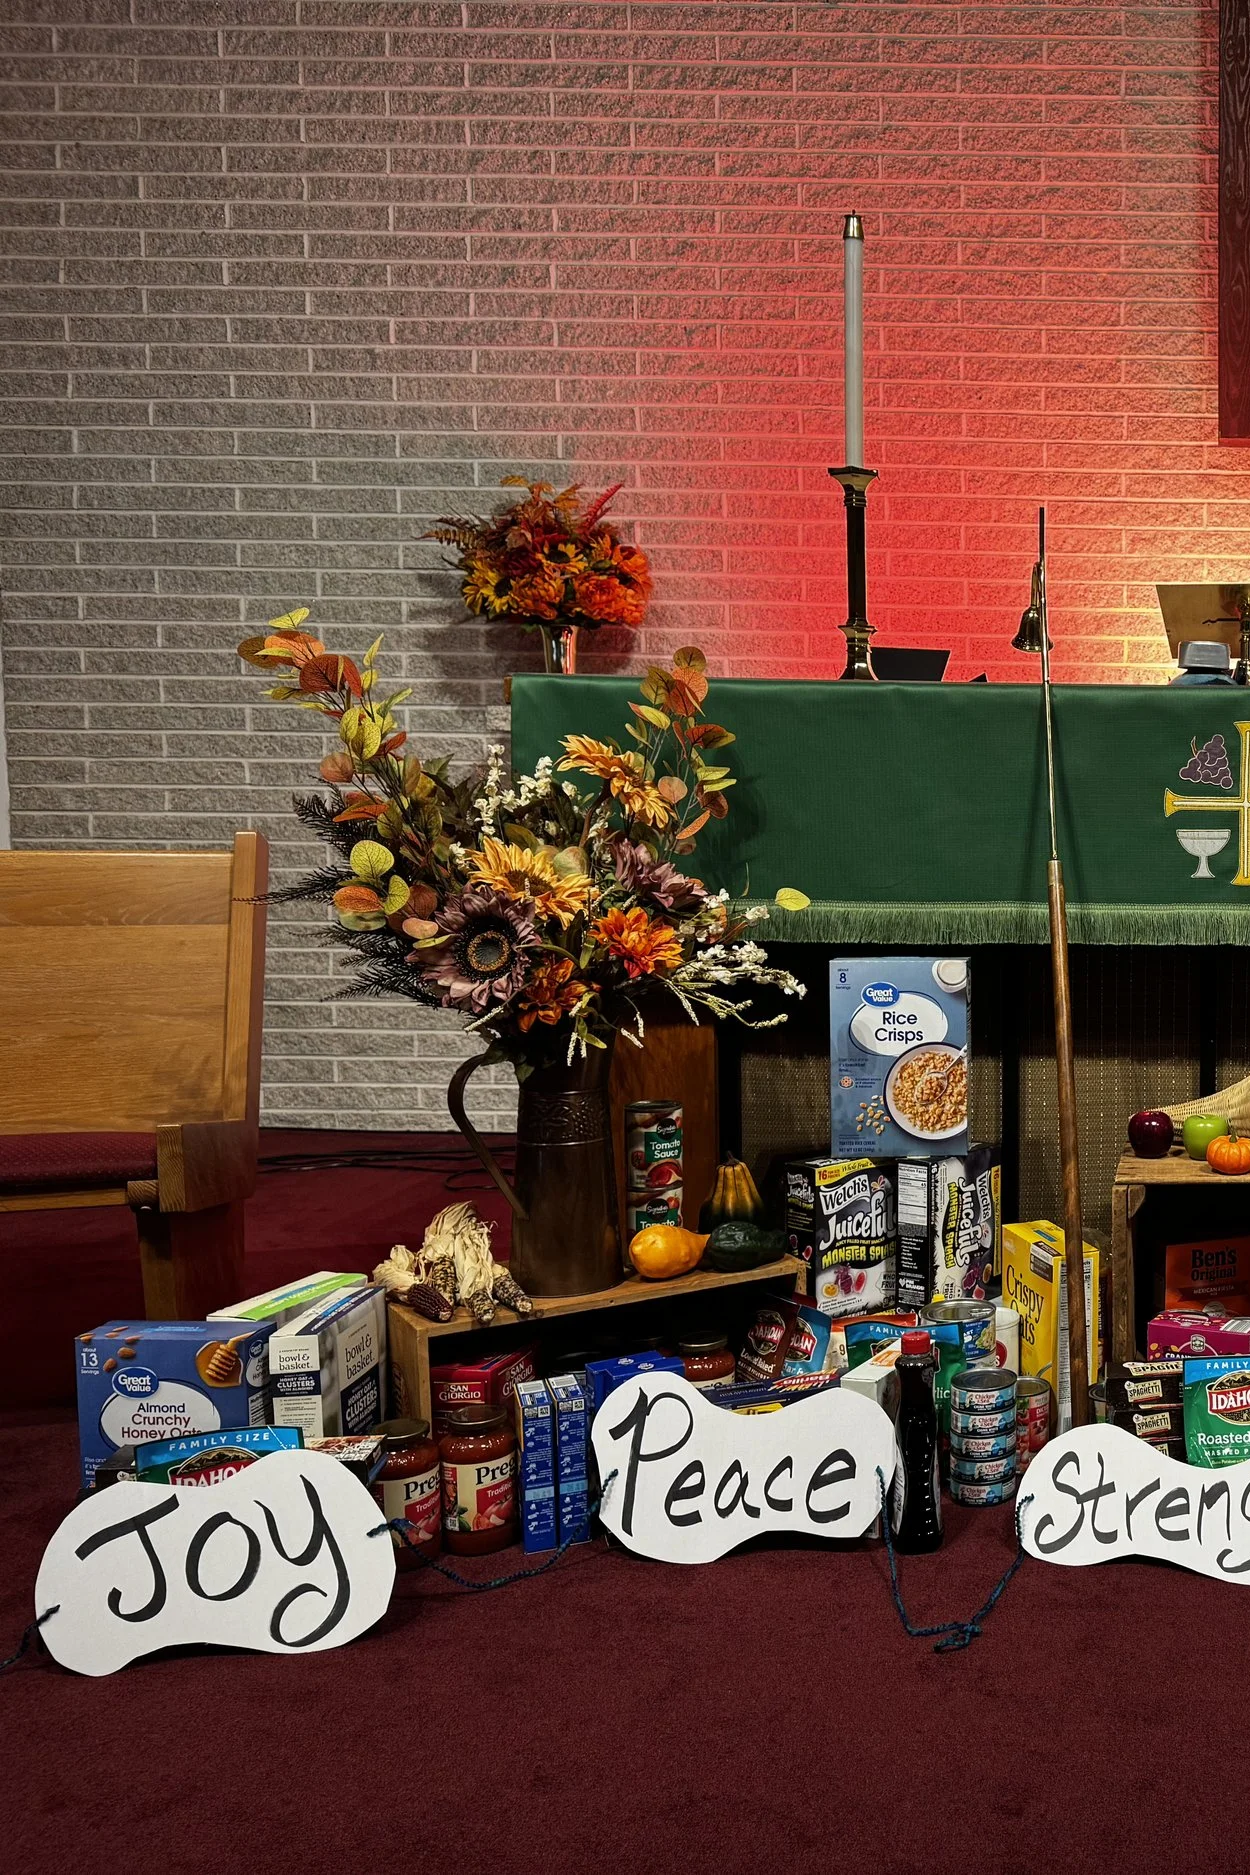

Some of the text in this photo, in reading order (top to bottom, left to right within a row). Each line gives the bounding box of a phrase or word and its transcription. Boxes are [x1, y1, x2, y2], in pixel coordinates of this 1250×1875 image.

[839, 972, 847, 983] 8
[866, 987, 893, 997] Great
[882, 1011, 918, 1025] Rice
[874, 1028, 923, 1044] Crisps
[650, 1139, 681, 1151] Tomato
[654, 1148, 678, 1159] Sauce
[817, 1169, 828, 1181] 16
[822, 1177, 868, 1212] Welch's
[977, 1175, 991, 1220] Welch's
[946, 1181, 960, 1230] MONSTER
[955, 1176, 983, 1268] Juicefuls
[944, 1231, 957, 1269] SPLASH
[822, 1245, 866, 1270] MONSTER
[1191, 1247, 1237, 1268] Ben's
[1191, 1265, 1237, 1281] Original
[1006, 1264, 1045, 1324] Crispy
[1193, 1284, 1235, 1295] MEXICAN FIESTA
[869, 1325, 905, 1336] FAMILY
[345, 1336, 366, 1363] bowl
[81, 1353, 99, 1367] 13
[279, 1353, 310, 1363] bowl &
[279, 1362, 310, 1371] basket
[346, 1350, 374, 1380] basket
[510, 1361, 525, 1380] SAN
[1206, 1361, 1249, 1369] FAMILY
[118, 1374, 151, 1386] Great
[277, 1380, 315, 1388] CLUSTERS
[782, 1374, 831, 1385] Barilla
[126, 1383, 152, 1392] Value
[1128, 1385, 1161, 1397] SPAGHETTI
[438, 1391, 481, 1401] GIORGIO
[137, 1403, 186, 1413] Almond
[345, 1387, 378, 1422] CLUSTERS
[131, 1413, 191, 1428] Crunchy
[1137, 1417, 1169, 1431] SPAGHETTI
[121, 1427, 166, 1440] Honey
[169, 1432, 271, 1452] FAMILY SIZE
[1205, 1448, 1240, 1456] MASHED
[609, 1387, 857, 1536] Peace
[985, 1462, 1004, 1470] Chicken
